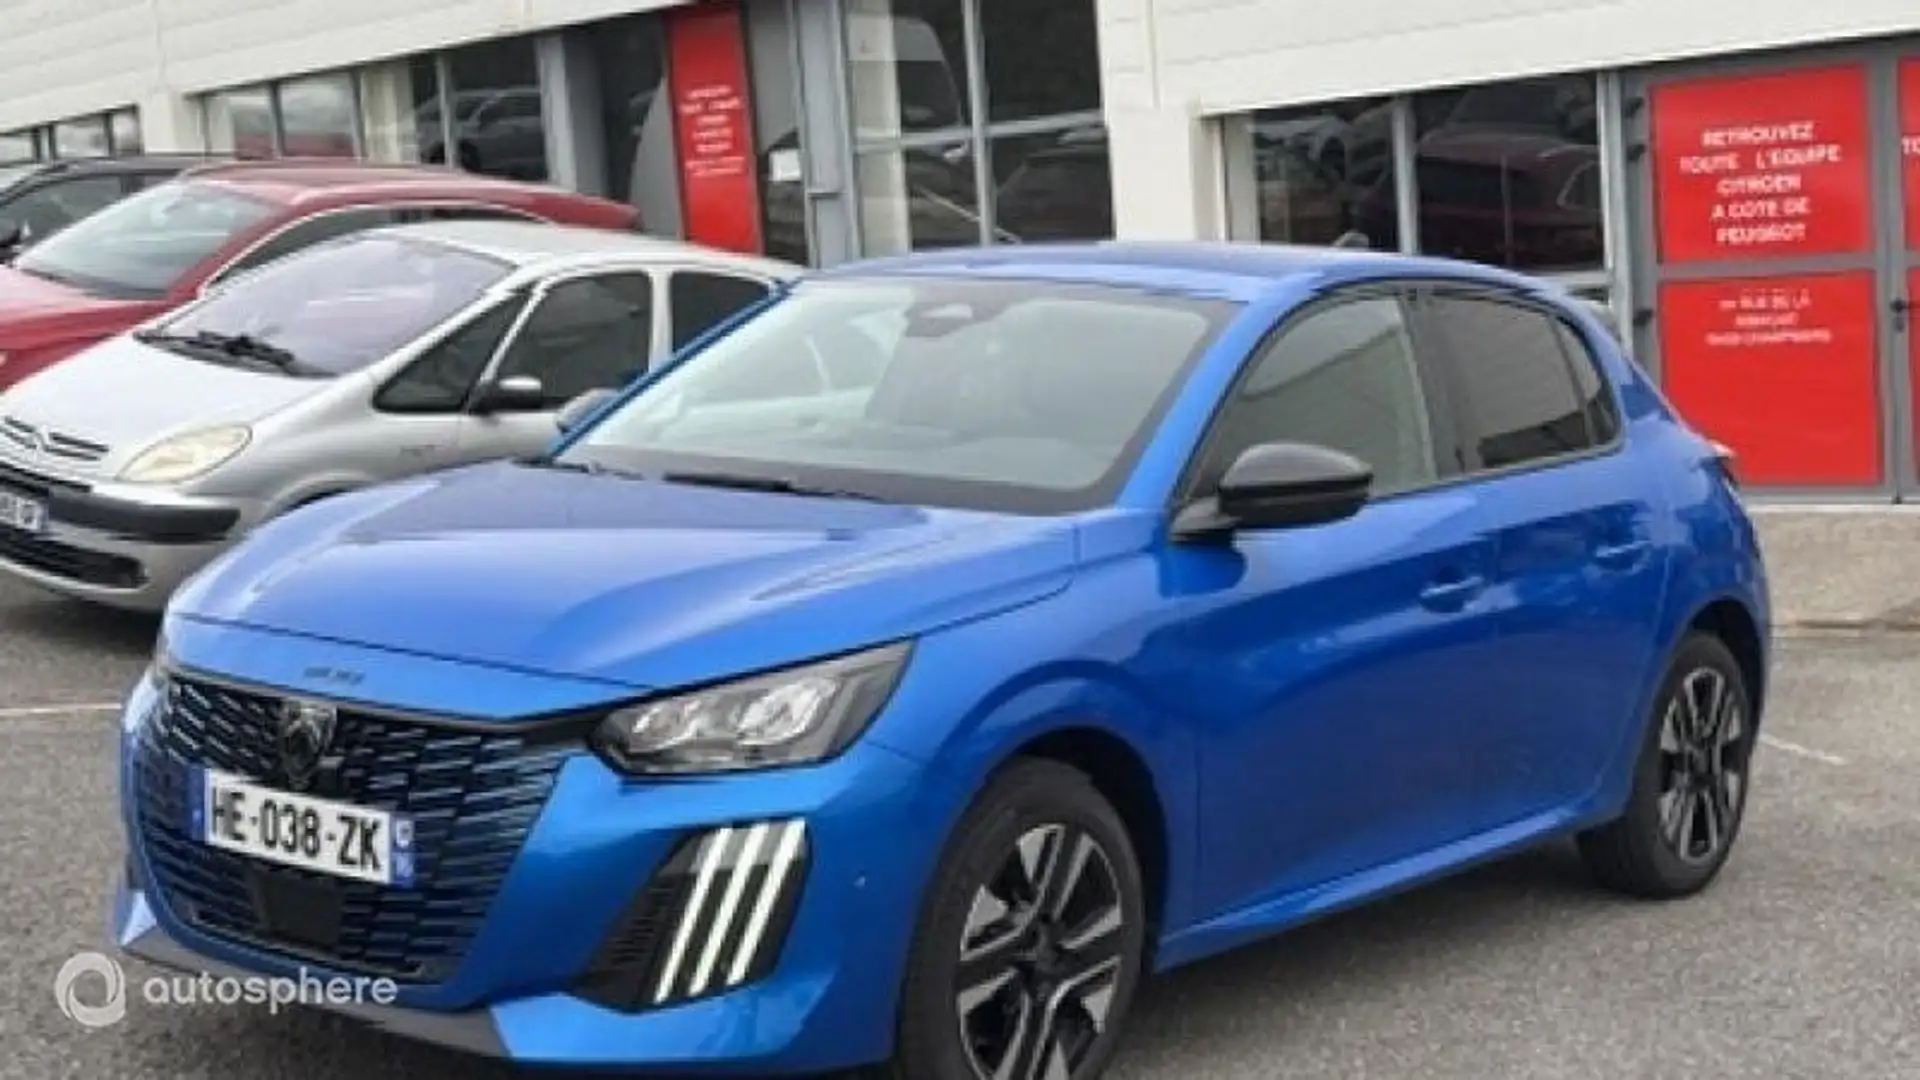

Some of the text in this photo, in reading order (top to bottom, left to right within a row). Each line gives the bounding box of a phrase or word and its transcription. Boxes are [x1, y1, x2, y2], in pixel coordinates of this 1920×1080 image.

[1702, 120, 1813, 146] RETROUVEZ
[1679, 153, 1740, 173] TOUTE
[1715, 223, 1807, 244] PEUGEOT
[211, 786, 382, 873] HE-038-ZK
